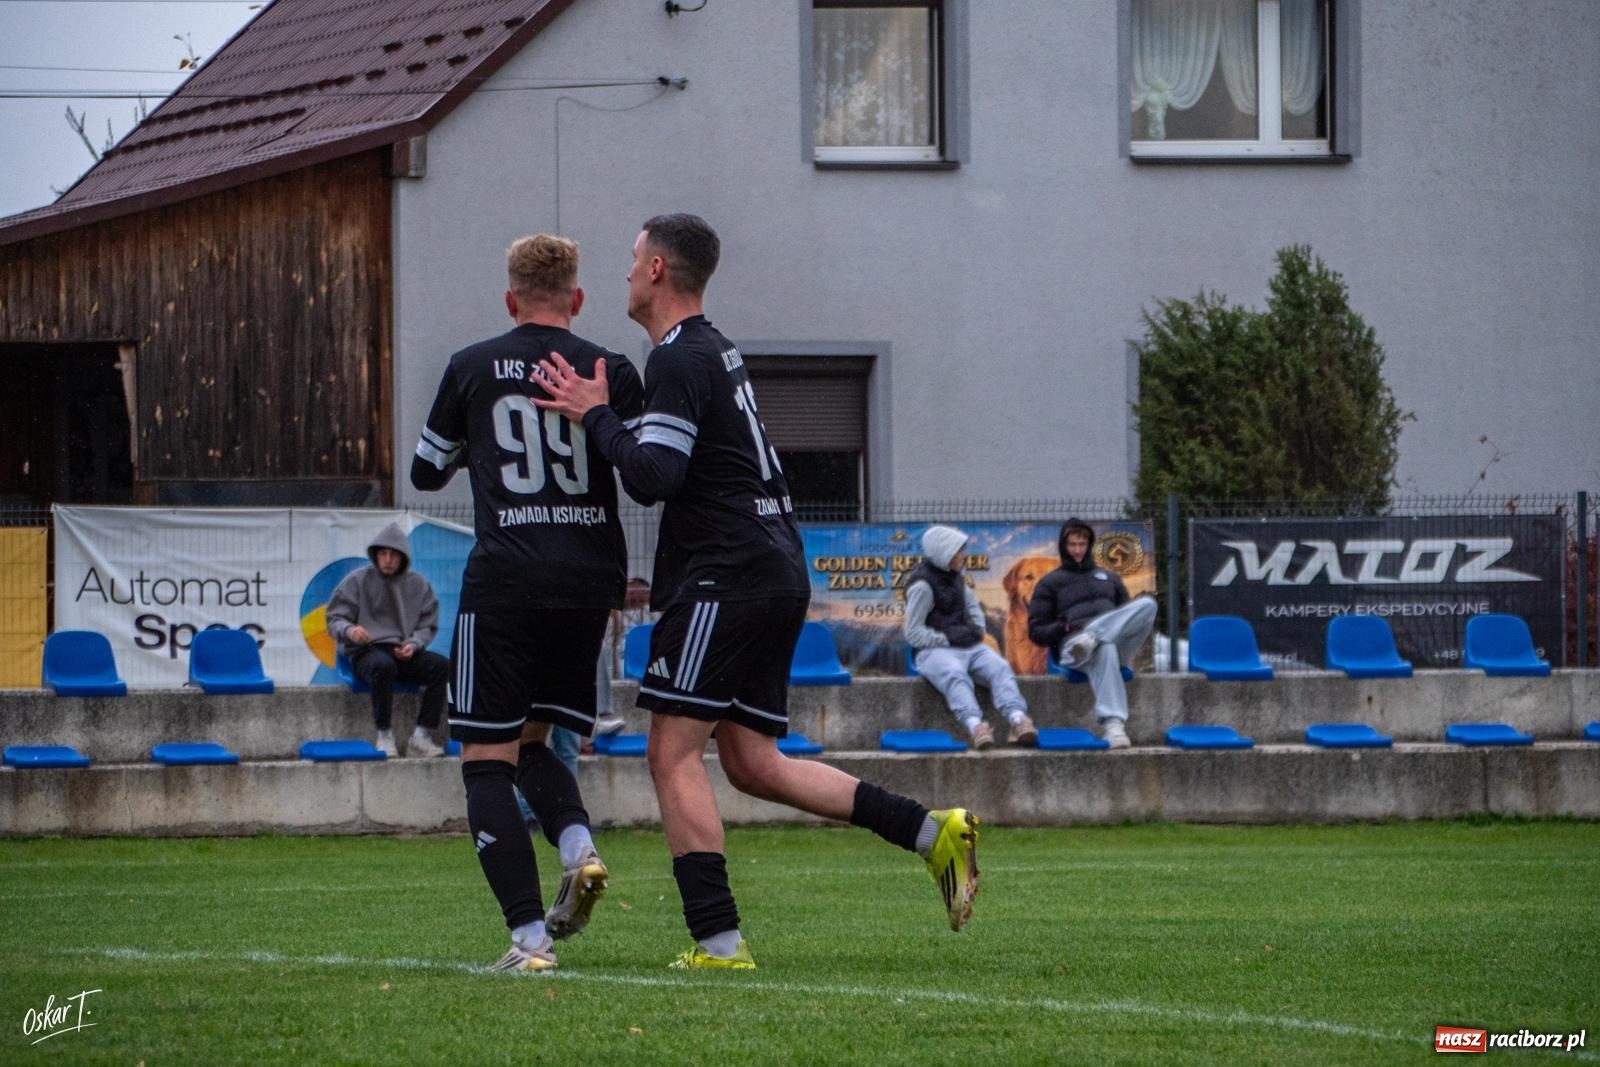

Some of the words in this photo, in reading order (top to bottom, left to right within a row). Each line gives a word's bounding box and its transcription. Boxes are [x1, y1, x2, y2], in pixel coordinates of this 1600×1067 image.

[494, 359, 525, 380] LKS
[492, 395, 590, 496] 99
[498, 505, 551, 528] ZAWADA
[813, 555, 887, 572] GOLDEN
[1211, 536, 1543, 586] MATOZ
[76, 566, 268, 608] Automat
[1265, 604, 1351, 618] KAMPERY
[1354, 601, 1490, 617] EKSPEDYCYJNE
[134, 613, 267, 660] Spc
